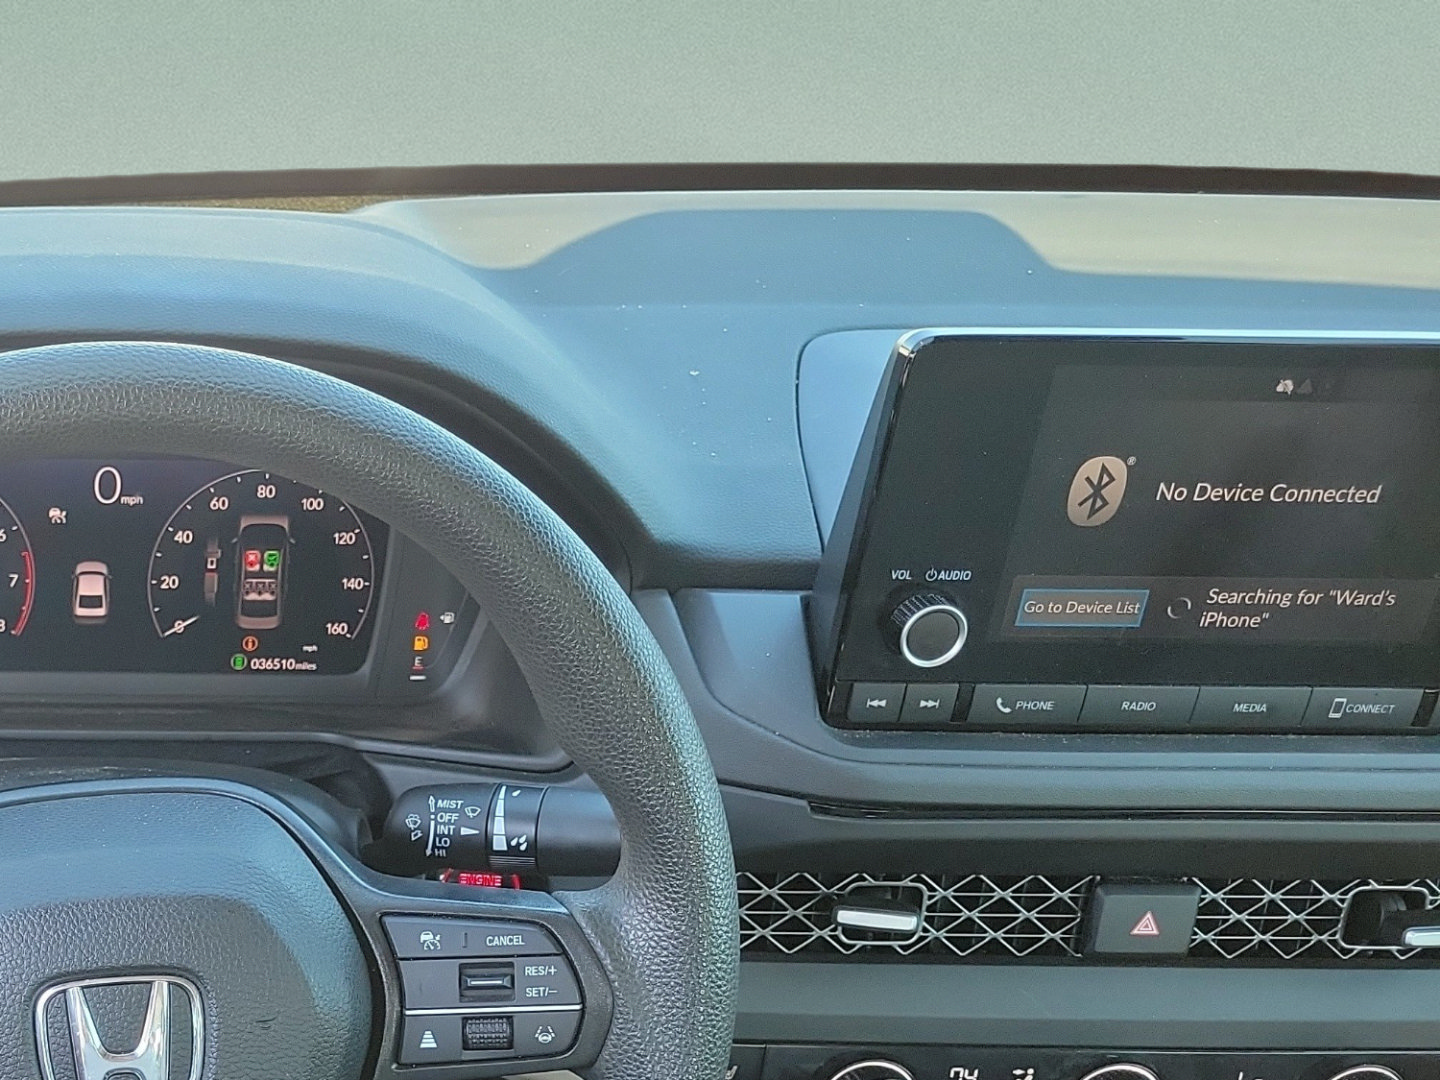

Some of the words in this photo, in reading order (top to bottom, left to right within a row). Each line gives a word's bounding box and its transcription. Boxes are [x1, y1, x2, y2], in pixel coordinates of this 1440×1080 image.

[257, 485, 275, 498] 80
[1156, 482, 1187, 501] No
[1193, 483, 1263, 502] Device
[1269, 483, 1381, 503] Connected
[210, 498, 229, 510] 60
[301, 498, 324, 510] 100
[174, 531, 193, 544] 40
[333, 533, 356, 545] 120
[9, 574, 18, 587] 7
[891, 569, 912, 580] VOL
[938, 570, 972, 581] AUDIO
[160, 576, 179, 589] 20
[342, 578, 363, 590] 140
[1207, 588, 1292, 608] Searching
[1296, 589, 1324, 606] for
[1024, 601, 1045, 613] Go
[1047, 602, 1062, 613] to
[1065, 601, 1113, 614] Device
[1116, 602, 1140, 614] List
[1199, 611, 1269, 628] iPhone"
[325, 622, 348, 635] 160
[250, 658, 296, 670] 036510
[414, 657, 422, 667] E
[1016, 701, 1055, 711] PHONE
[1121, 701, 1156, 711] RADIO
[1233, 703, 1268, 713] MEDIA
[1346, 704, 1395, 714] CONNECT
[437, 799, 464, 809] MIST
[437, 812, 459, 823] OFF
[437, 824, 456, 835] INT
[435, 836, 450, 847] LO
[434, 849, 446, 857] HI
[460, 873, 502, 886] ENGINE
[486, 934, 525, 946] CANCEL
